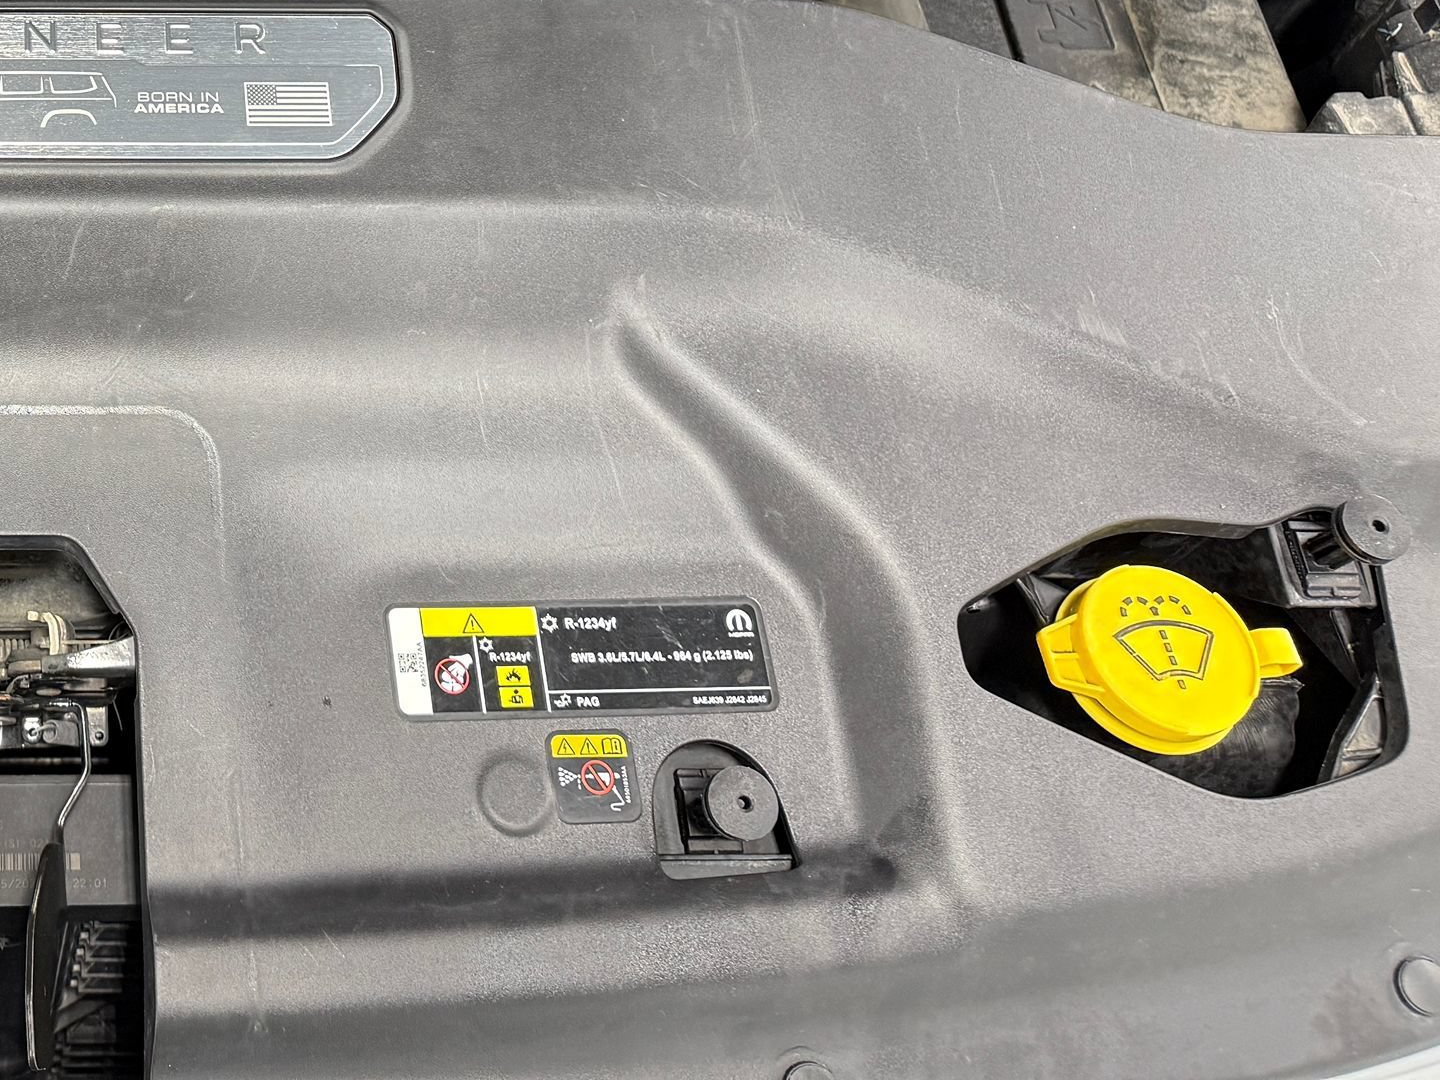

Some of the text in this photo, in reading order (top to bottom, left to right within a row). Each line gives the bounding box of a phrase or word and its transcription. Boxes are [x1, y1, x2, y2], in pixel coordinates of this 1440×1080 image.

[137, 92, 219, 102] BORN IN
[134, 103, 225, 114] AMERICA
[570, 652, 596, 664] SWB
[576, 697, 600, 708] PAG
